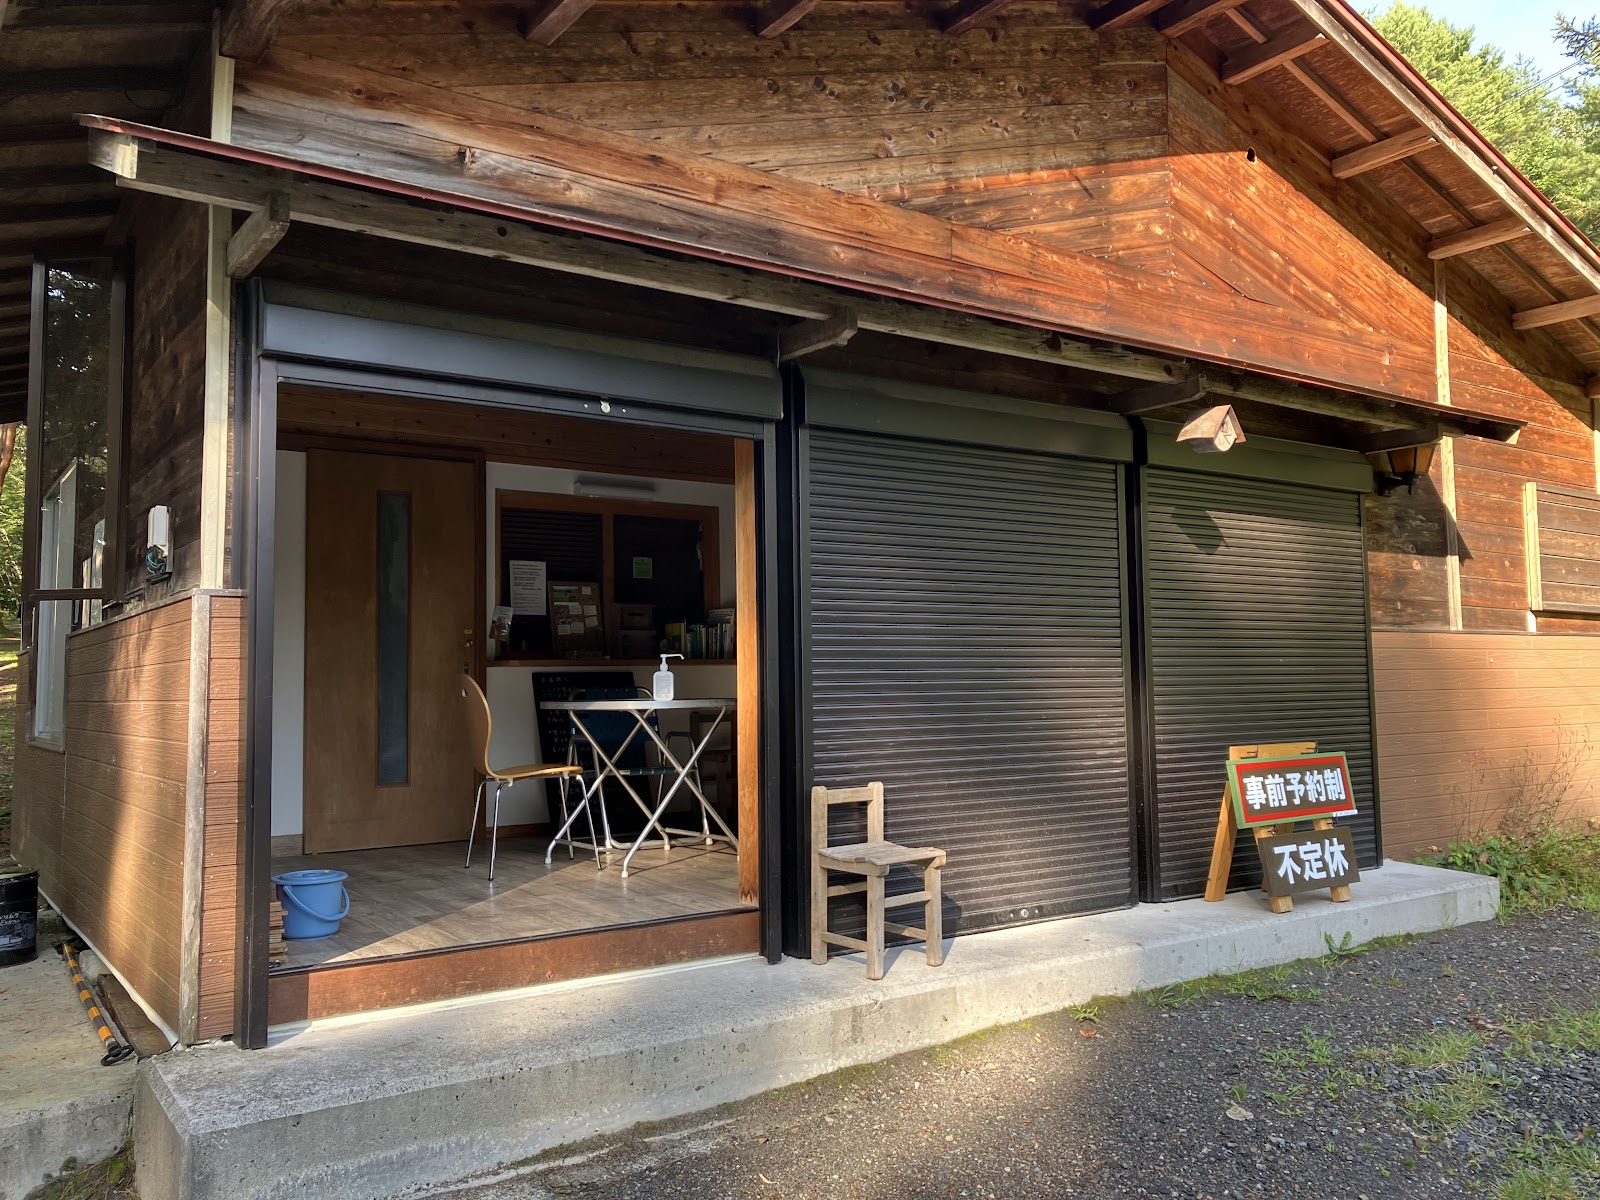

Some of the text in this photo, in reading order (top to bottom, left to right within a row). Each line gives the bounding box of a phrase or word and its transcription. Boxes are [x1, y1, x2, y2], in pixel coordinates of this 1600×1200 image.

[1243, 768, 1346, 809] 事前予約制
[1274, 838, 1349, 884] 不定休
